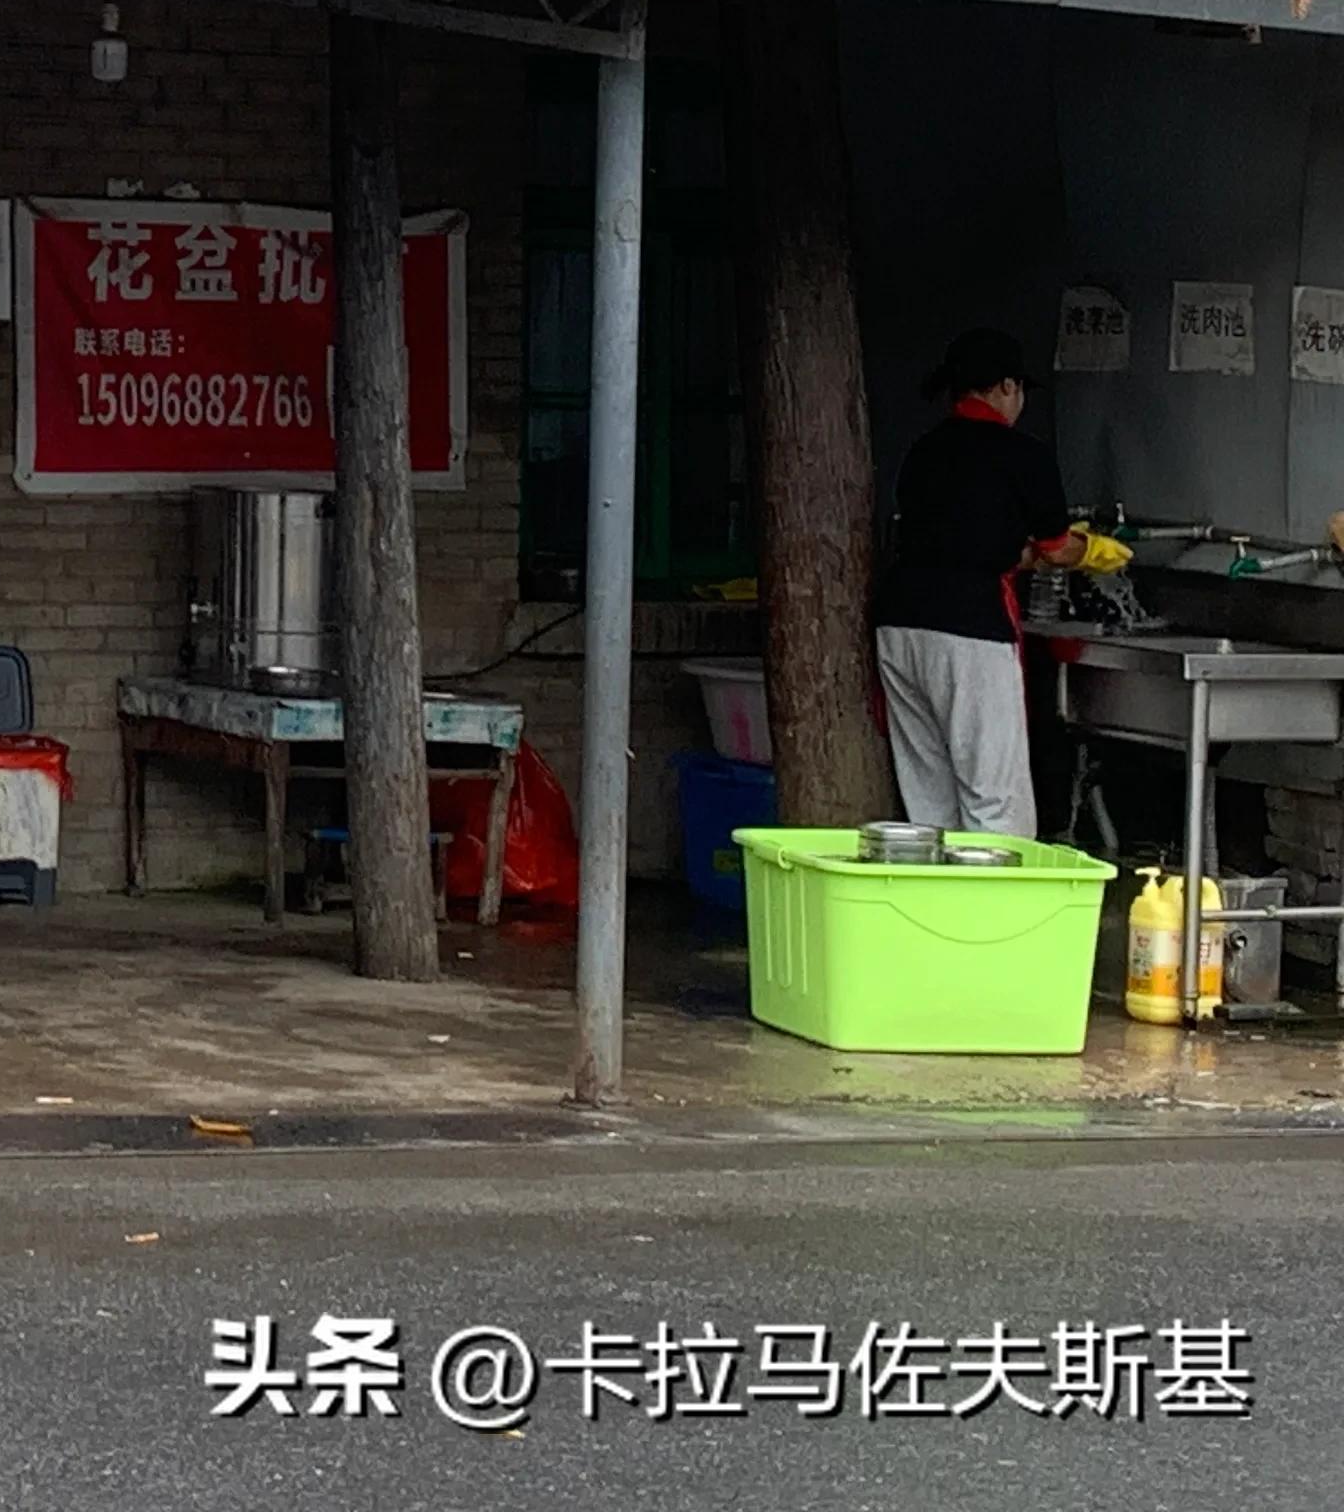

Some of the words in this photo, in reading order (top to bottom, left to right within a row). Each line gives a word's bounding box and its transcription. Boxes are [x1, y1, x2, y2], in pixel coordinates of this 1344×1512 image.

[86, 221, 409, 305] 花盆批
[73, 326, 188, 358] 联系电话：
[1179, 303, 1247, 338] 洗肉池
[76, 371, 313, 428] 15096882766
